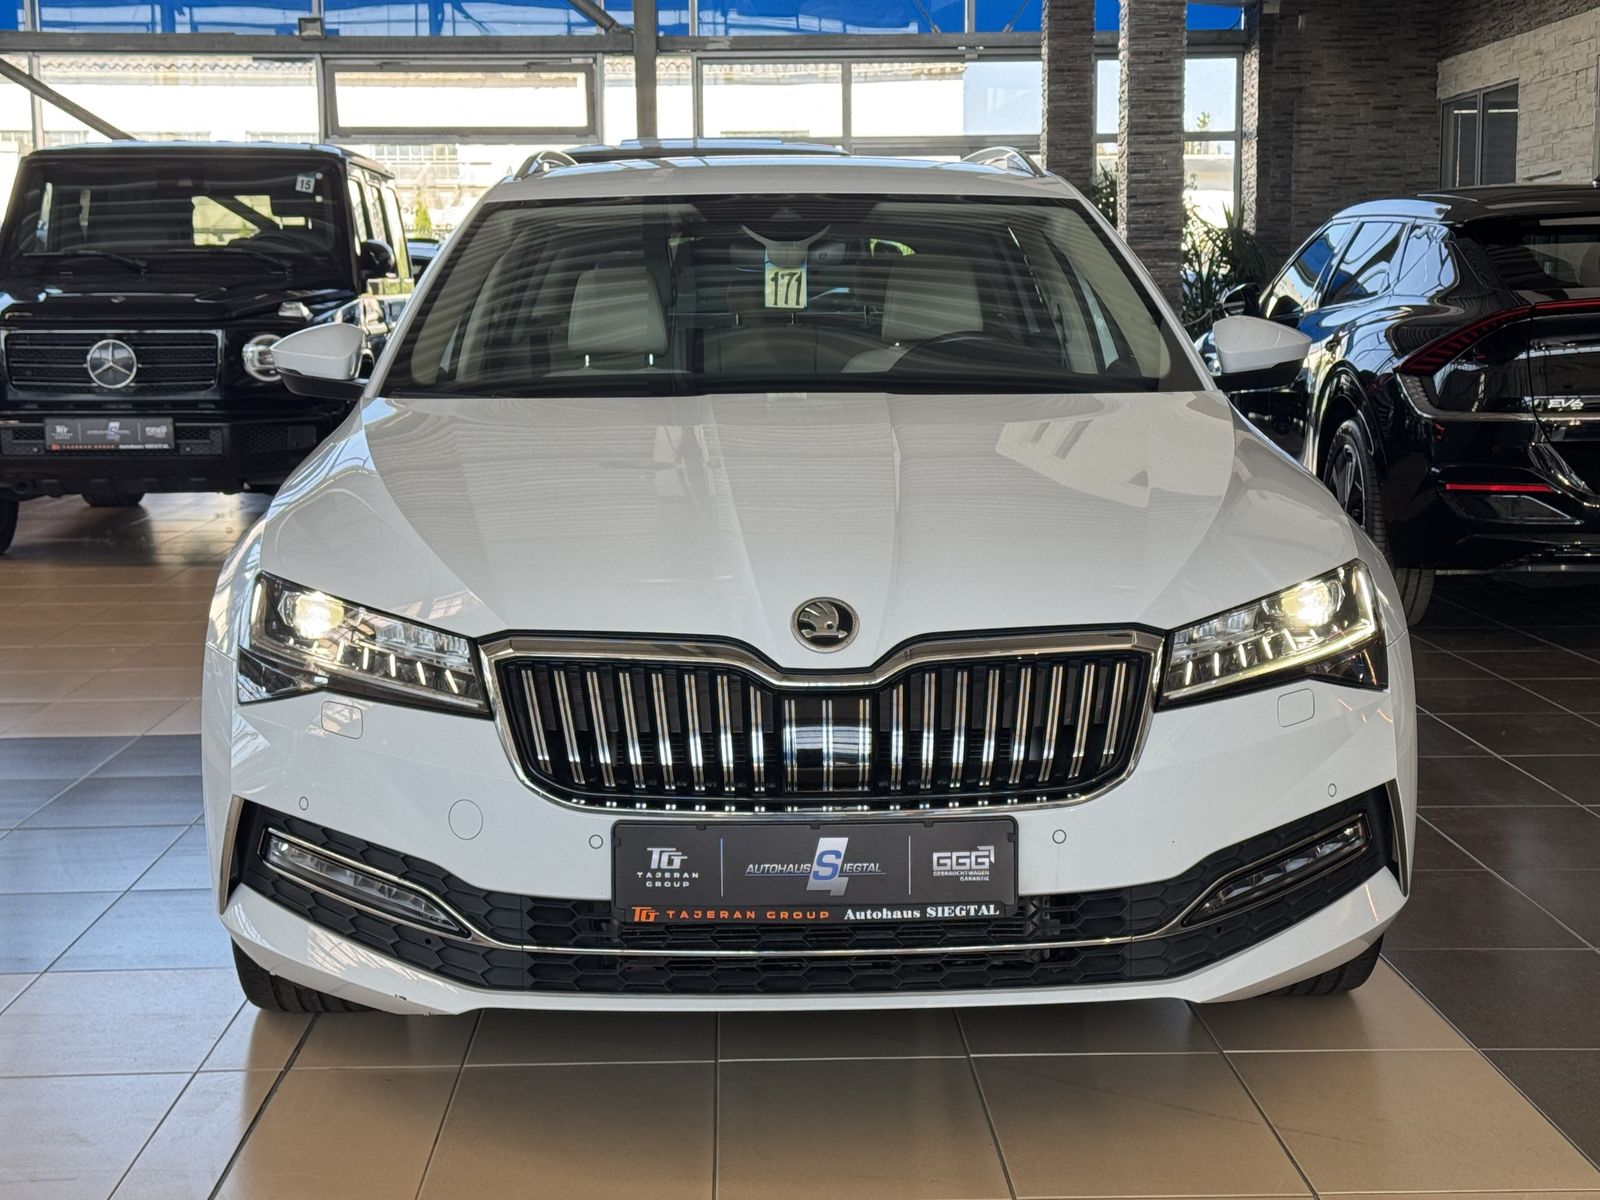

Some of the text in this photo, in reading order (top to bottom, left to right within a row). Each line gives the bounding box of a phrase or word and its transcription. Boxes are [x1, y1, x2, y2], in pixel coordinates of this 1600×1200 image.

[300, 179, 312, 190] 15
[770, 271, 803, 306] 171
[1548, 399, 1584, 409] EV6
[932, 850, 990, 871] GGG
[745, 863, 812, 874] AUTOHAUS
[636, 871, 699, 879] TAJERAN
[666, 910, 756, 919] TAJERAN
[766, 910, 829, 919] GROUP
[844, 904, 1000, 920] Autohaus SIEGTAL
